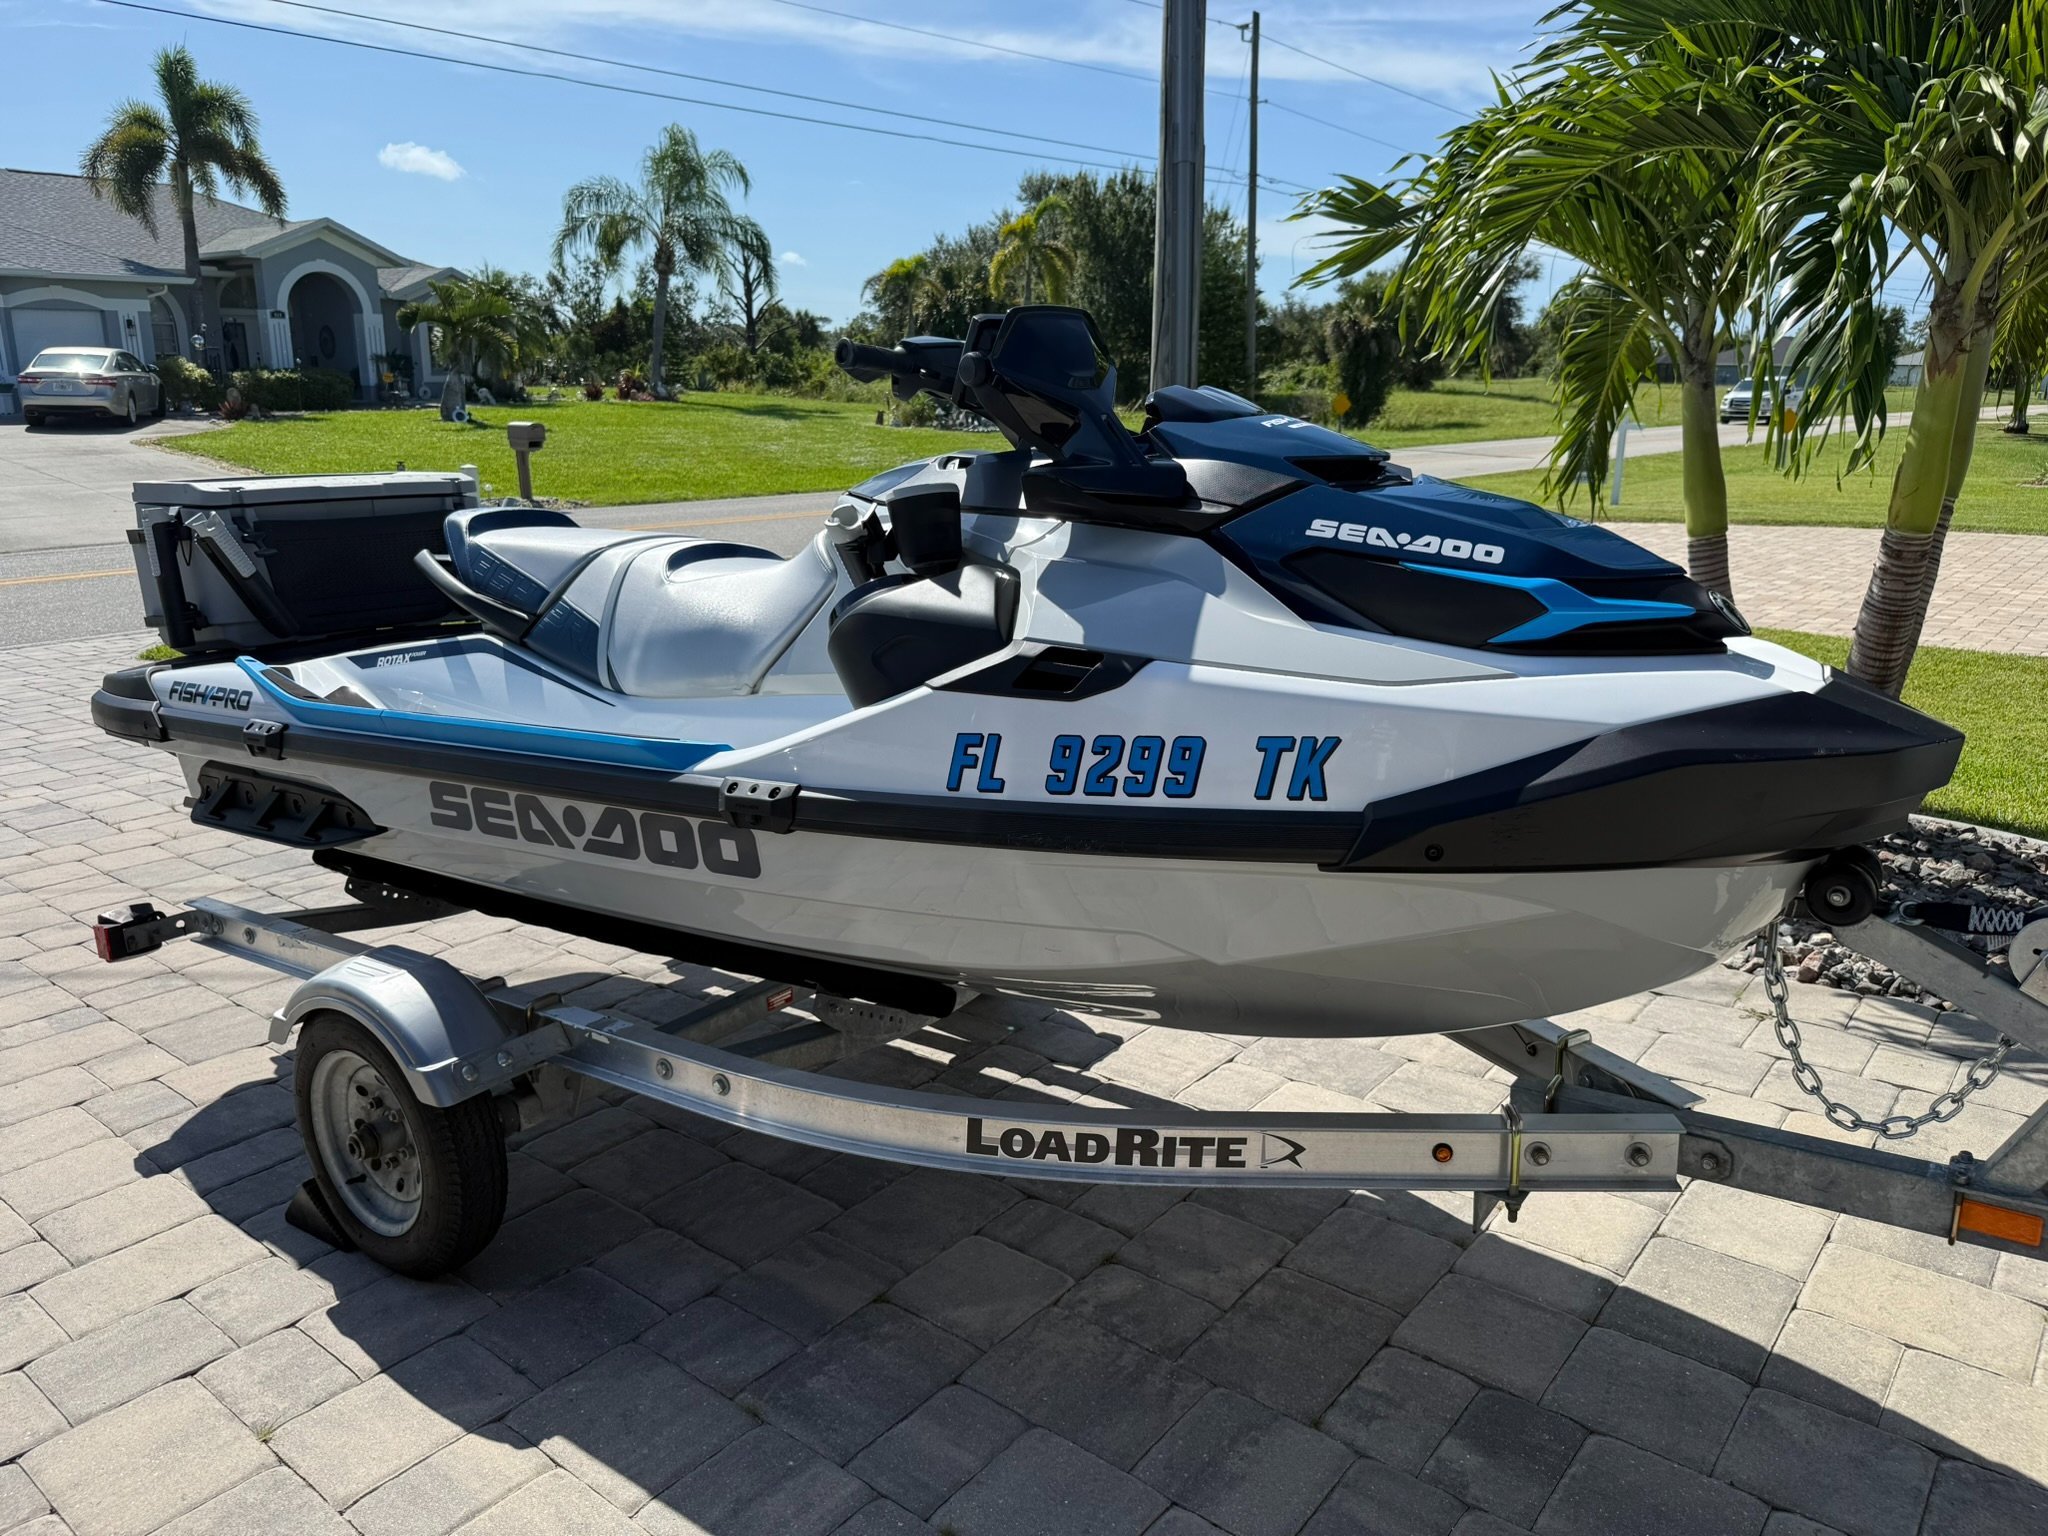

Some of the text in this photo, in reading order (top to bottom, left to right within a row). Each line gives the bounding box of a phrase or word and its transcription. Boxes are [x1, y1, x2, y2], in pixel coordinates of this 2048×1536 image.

[377, 652, 412, 668] ROTAX
[946, 732, 1343, 802] FL 9299 TK
